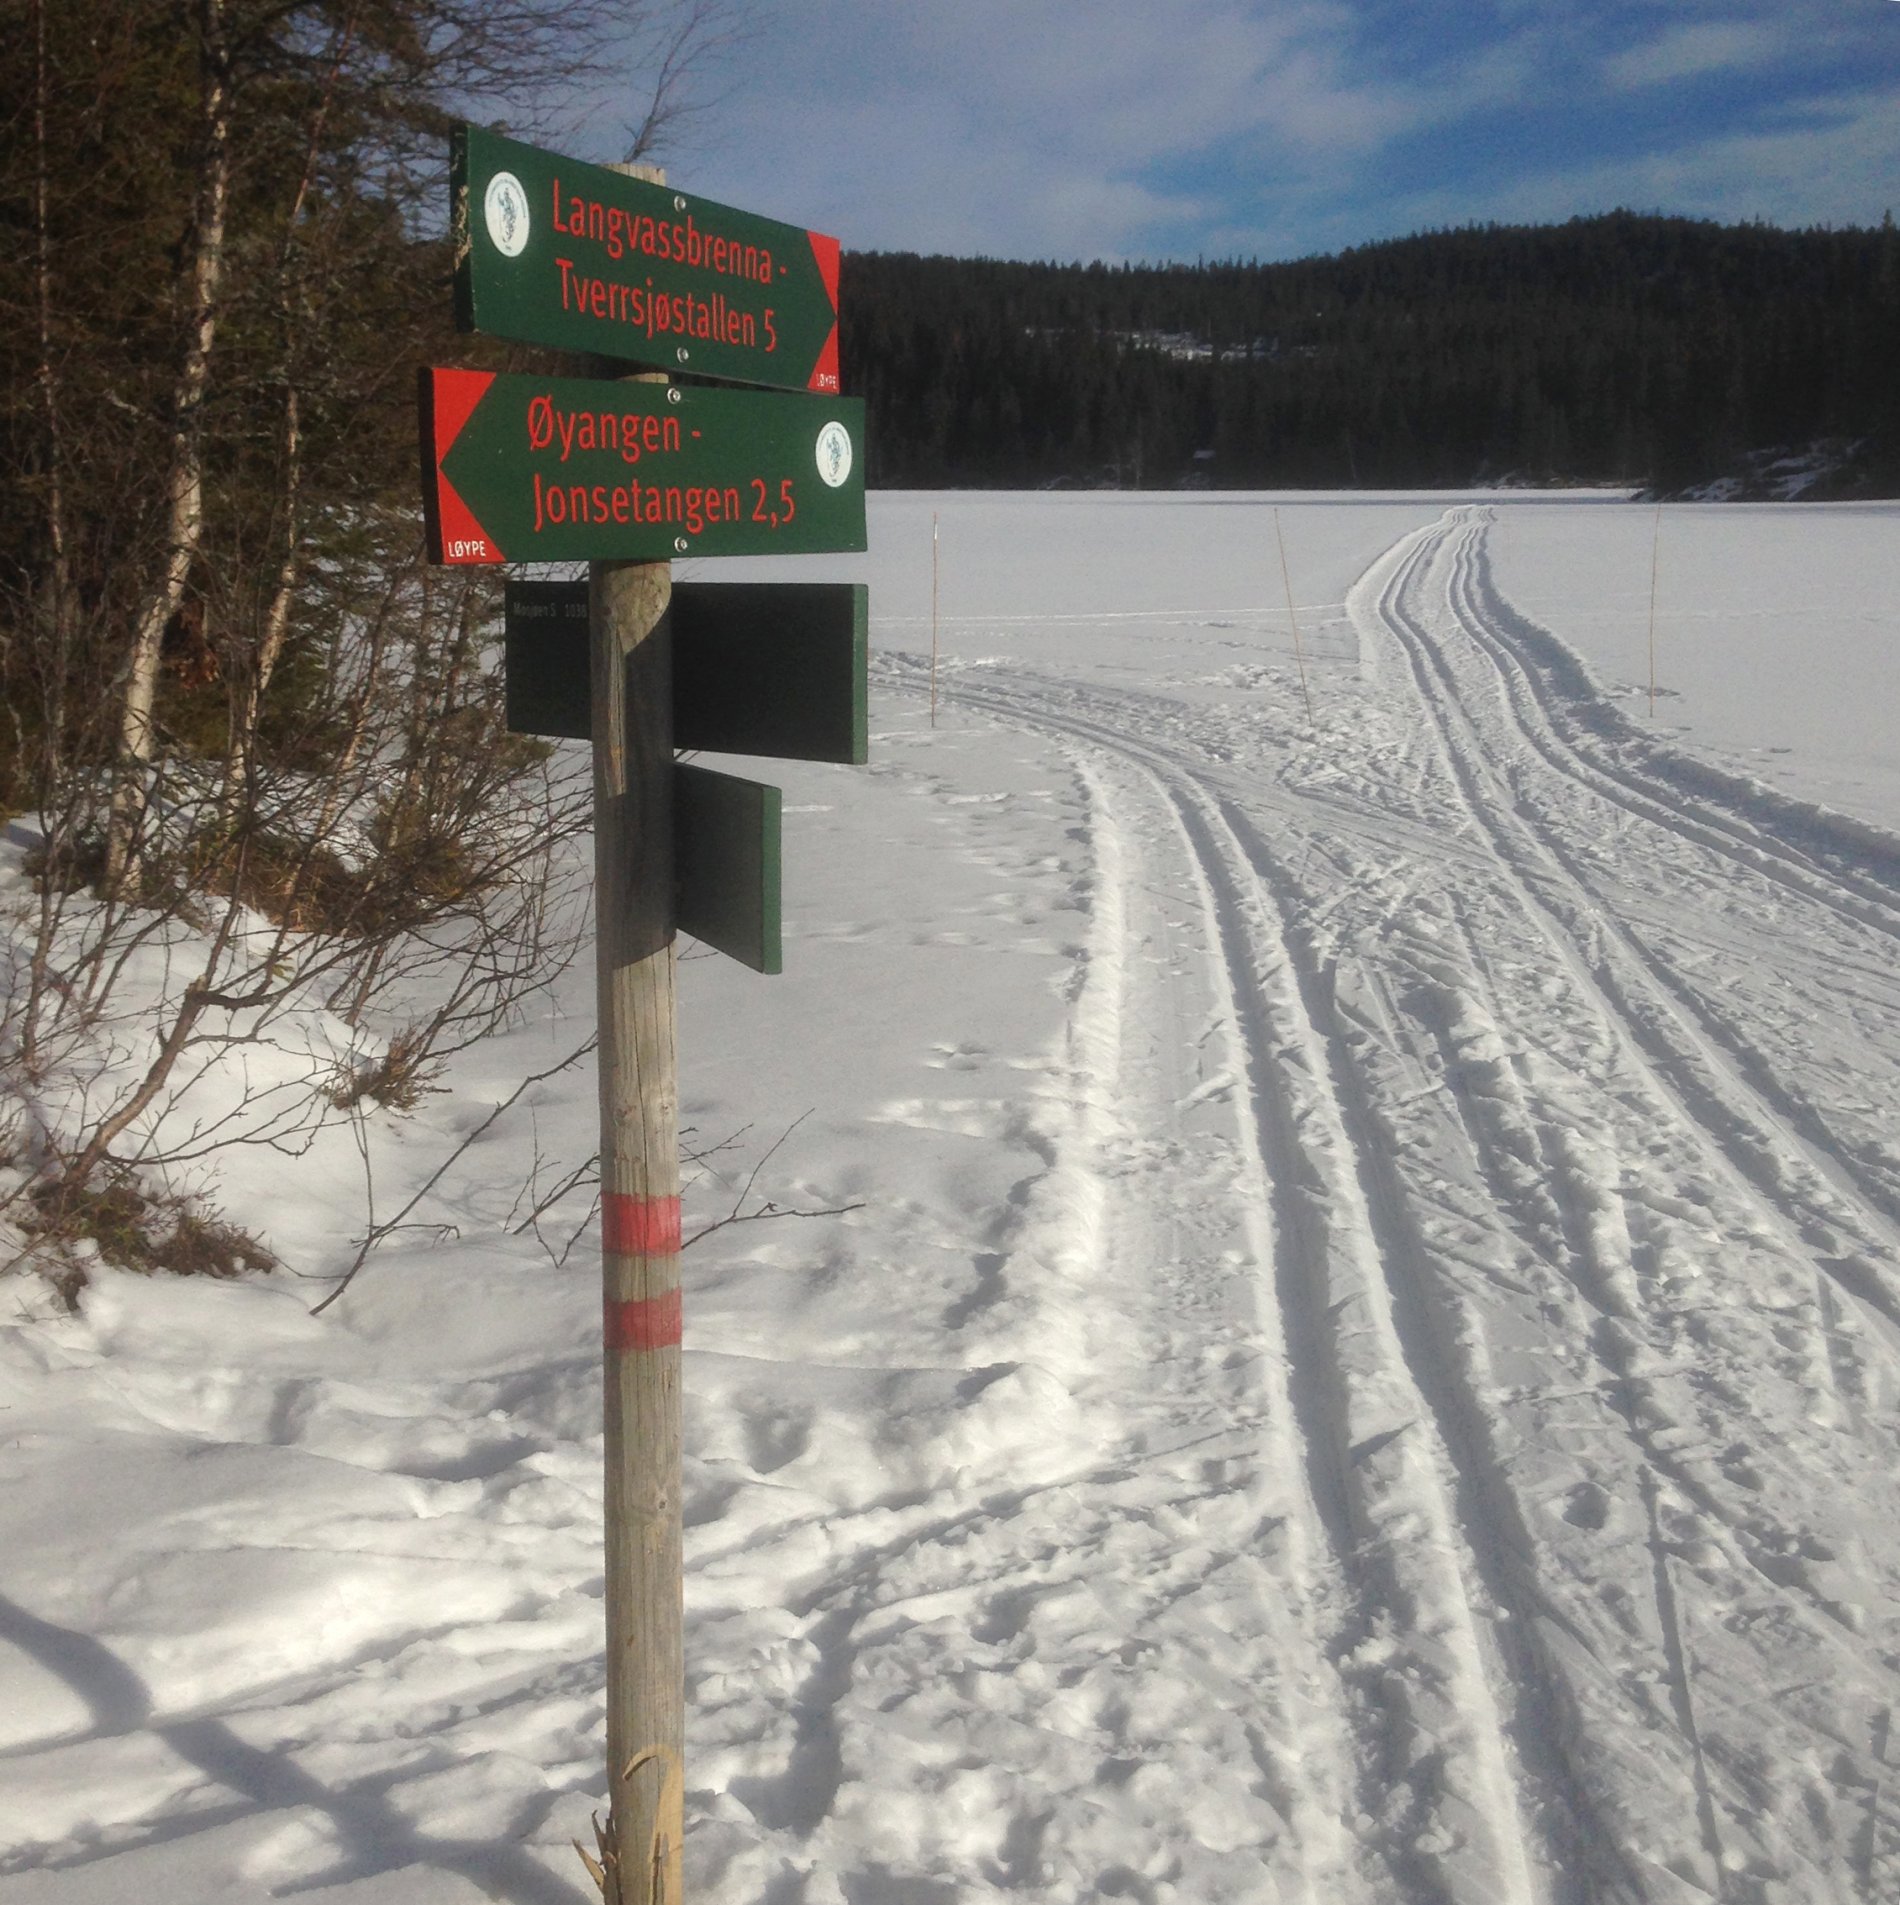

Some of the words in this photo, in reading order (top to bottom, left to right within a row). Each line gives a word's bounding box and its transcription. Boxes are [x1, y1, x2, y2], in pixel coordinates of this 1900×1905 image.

[553, 178, 773, 284] Langvassbrenna
[555, 257, 756, 347] Tverrsjøstallen
[763, 308, 778, 353] 5
[527, 394, 681, 464] Øyangen
[533, 473, 741, 535] Jonsetangen
[751, 477, 797, 528] 2,5
[447, 540, 487, 558] LØYPE
